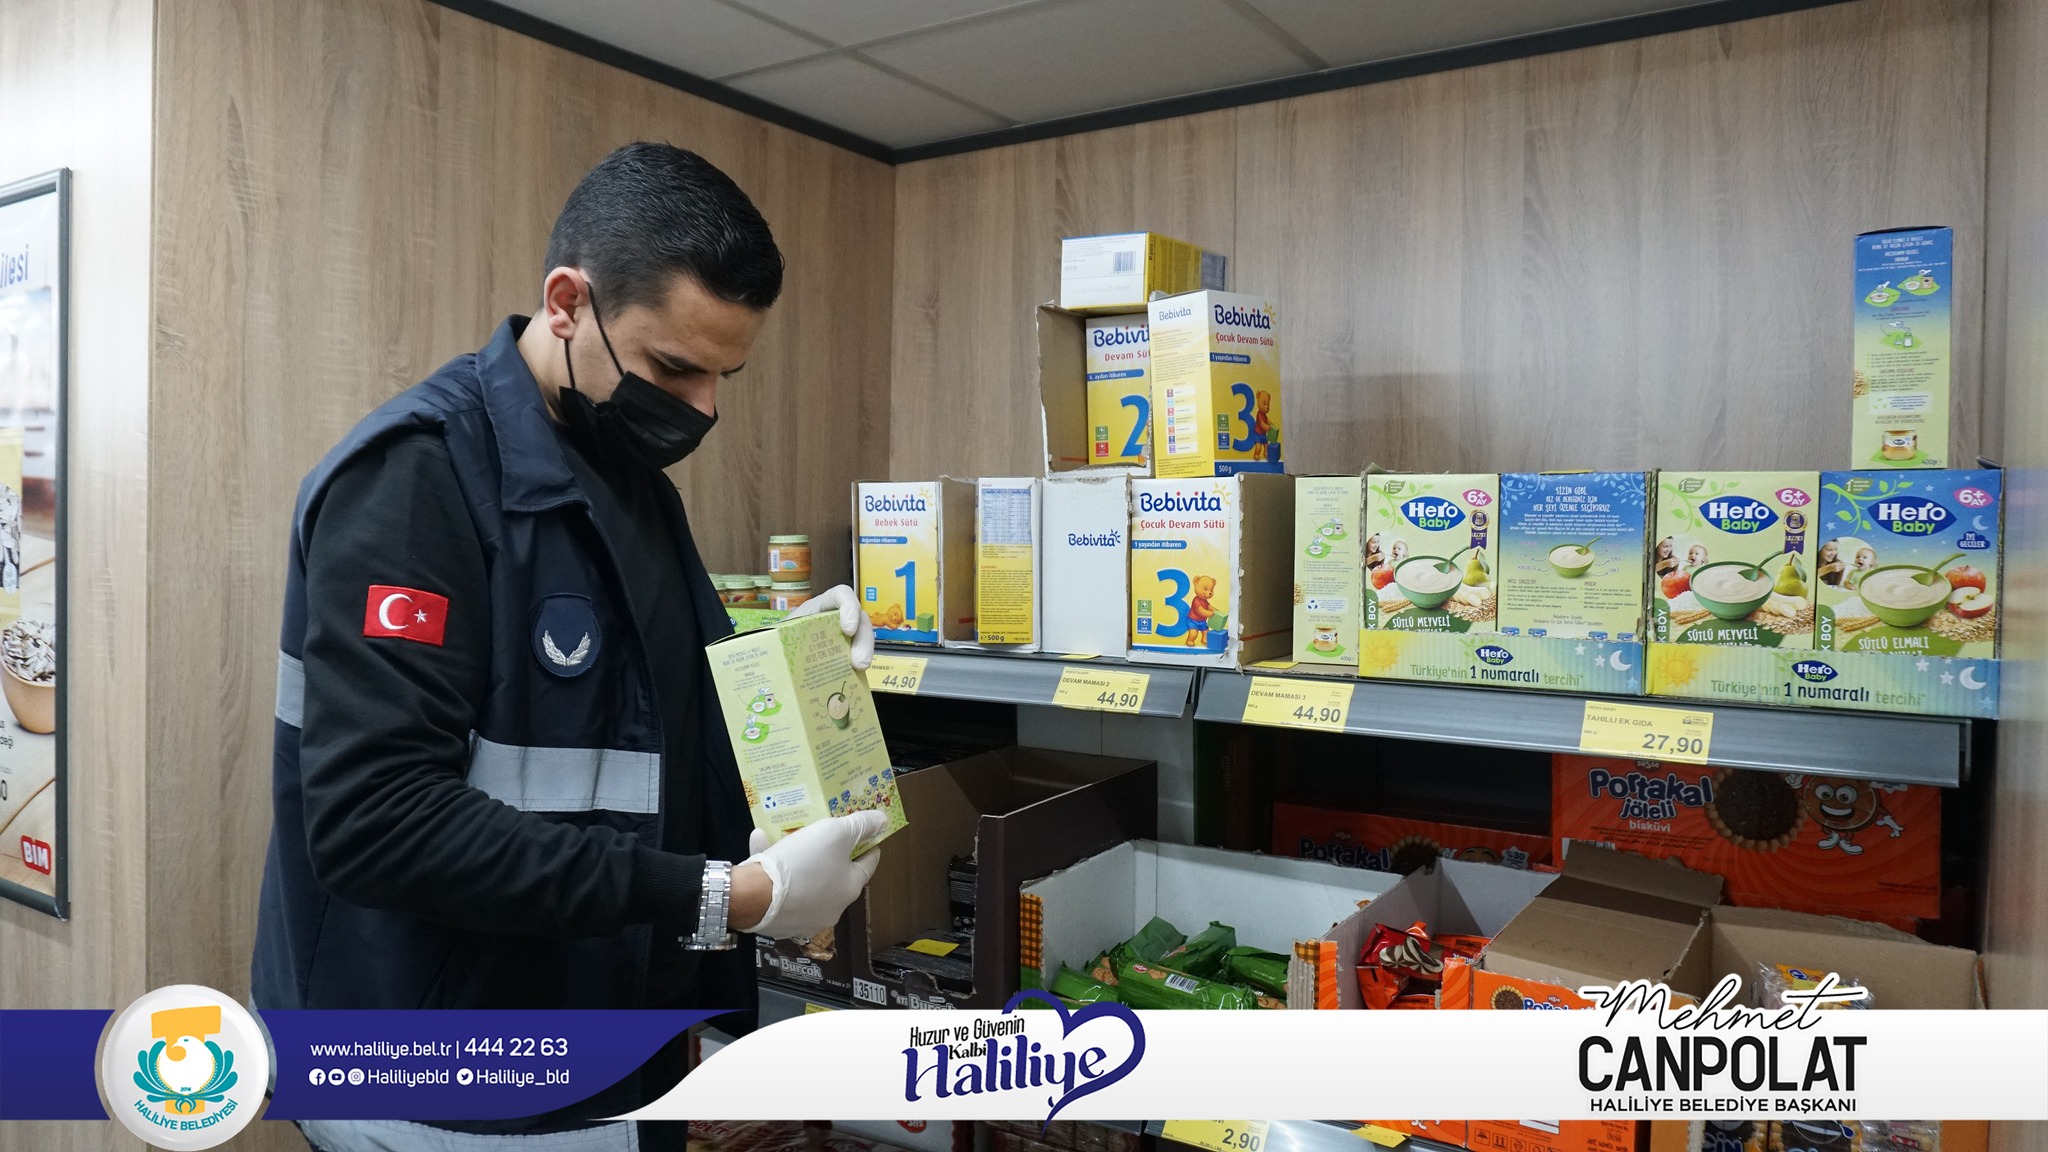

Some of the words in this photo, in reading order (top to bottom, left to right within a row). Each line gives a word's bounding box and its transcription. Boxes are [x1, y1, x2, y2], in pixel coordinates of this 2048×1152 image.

[1158, 307, 1192, 321] Bebivita
[1214, 304, 1271, 330] Bebivita
[1216, 332, 1236, 345] Çocuk
[1237, 334, 1259, 346] Devam
[1260, 336, 1274, 347] Sütü
[1104, 351, 1134, 362] Devam
[1231, 382, 1255, 453] 3
[1120, 395, 1150, 457] 2
[865, 494, 927, 512] Bebivita
[1140, 490, 1222, 513] Bebivita
[1408, 502, 1458, 518] Hero
[1708, 502, 1770, 519] Hero
[1878, 502, 1947, 521] Hero
[875, 518, 898, 527] Bebek
[901, 518, 918, 527] Sütü
[1140, 519, 1166, 531] Çocuk
[1169, 519, 1201, 529] Devam
[1203, 518, 1225, 529] Sütü
[1419, 517, 1451, 530] Baby
[1721, 518, 1760, 533] Baby
[1892, 520, 1936, 534] Baby
[1068, 532, 1116, 548] Bebivita
[1959, 540, 1986, 548] GECELER
[895, 560, 916, 621] 1
[1155, 568, 1191, 638] 3
[1368, 599, 1376, 620] BOY
[1392, 616, 1414, 628] SÜTLÜ
[1417, 614, 1451, 628] MEYVELİ
[1657, 608, 1667, 632] BOY
[1687, 628, 1714, 642] SÜTLÜ
[1717, 626, 1759, 641] MEYVELİ
[1821, 616, 1832, 641] BOY
[987, 634, 1000, 642] 500
[1858, 637, 1888, 650] SÜTLÜ
[1892, 636, 1930, 649] ELMALI
[1480, 648, 1509, 659] Hero
[1486, 656, 1505, 665] Baby
[1410, 664, 1467, 679] Türkiye'nin
[1470, 665, 1477, 679] 1
[1481, 668, 1539, 683] numaralı
[1797, 663, 1833, 675] Hero
[1804, 672, 1827, 682] Baby
[882, 674, 917, 689] 44,90
[1083, 679, 1105, 687] MAMASI
[1251, 690, 1275, 698] DEVAM
[1275, 692, 1301, 700] MAMASI
[1710, 680, 1780, 697] Türkiye'nin
[1784, 682, 1791, 697] 1
[1798, 685, 1870, 702] numaralı
[1097, 691, 1139, 708] 44,90
[1293, 705, 1341, 723] 44,90
[1587, 714, 1618, 724] TAHILLI
[1619, 717, 1630, 725] EK
[1632, 719, 1653, 728] GIDA
[1642, 733, 1704, 755] 27,90
[1588, 768, 1715, 807] Portakal
[1619, 797, 1677, 820] jöleli
[1629, 820, 1671, 833] bisküvi
[23, 840, 49, 870] BIM
[1299, 837, 1392, 872] Portakal
[858, 981, 886, 1004] 35110
[1222, 1128, 1261, 1152] 2,90
